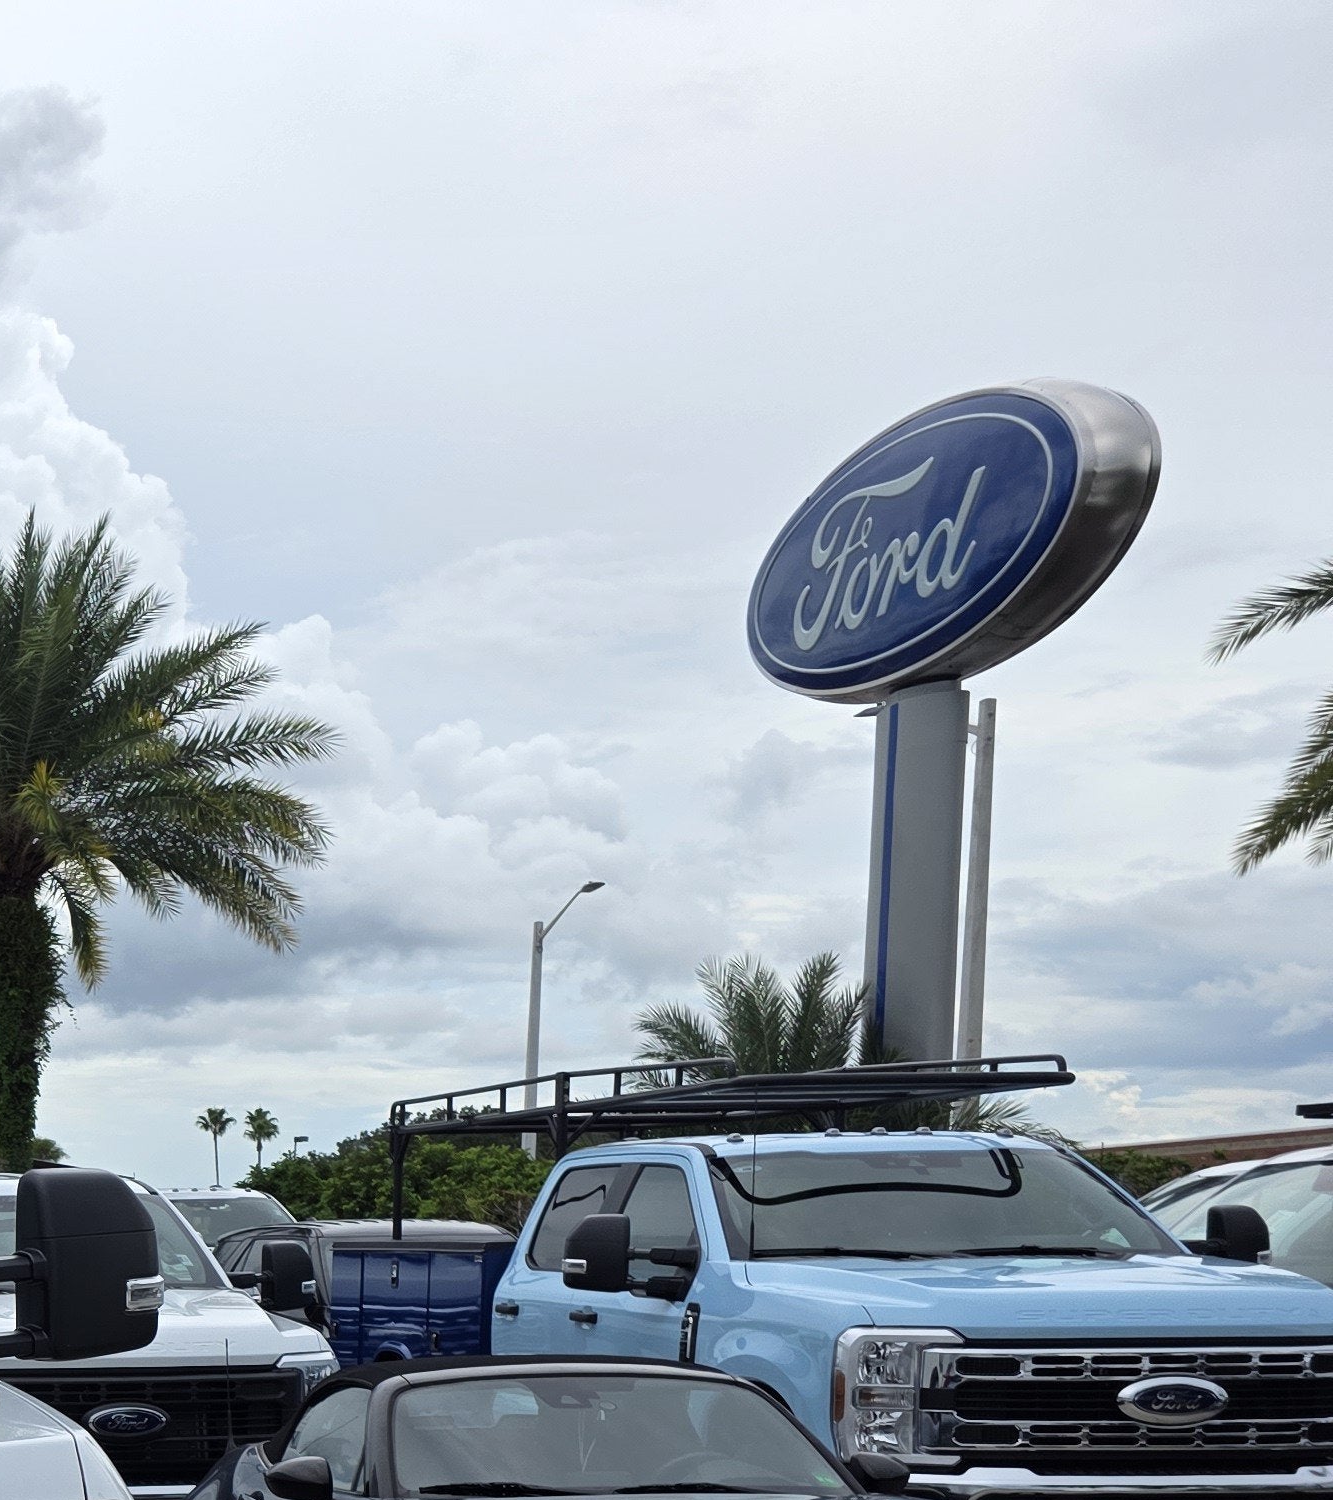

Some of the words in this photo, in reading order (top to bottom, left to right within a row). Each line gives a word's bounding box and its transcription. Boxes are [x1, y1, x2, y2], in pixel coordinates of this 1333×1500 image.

[793, 456, 986, 651] Ford
[1150, 1390, 1203, 1410] Ford
[107, 1413, 149, 1431] Ford
